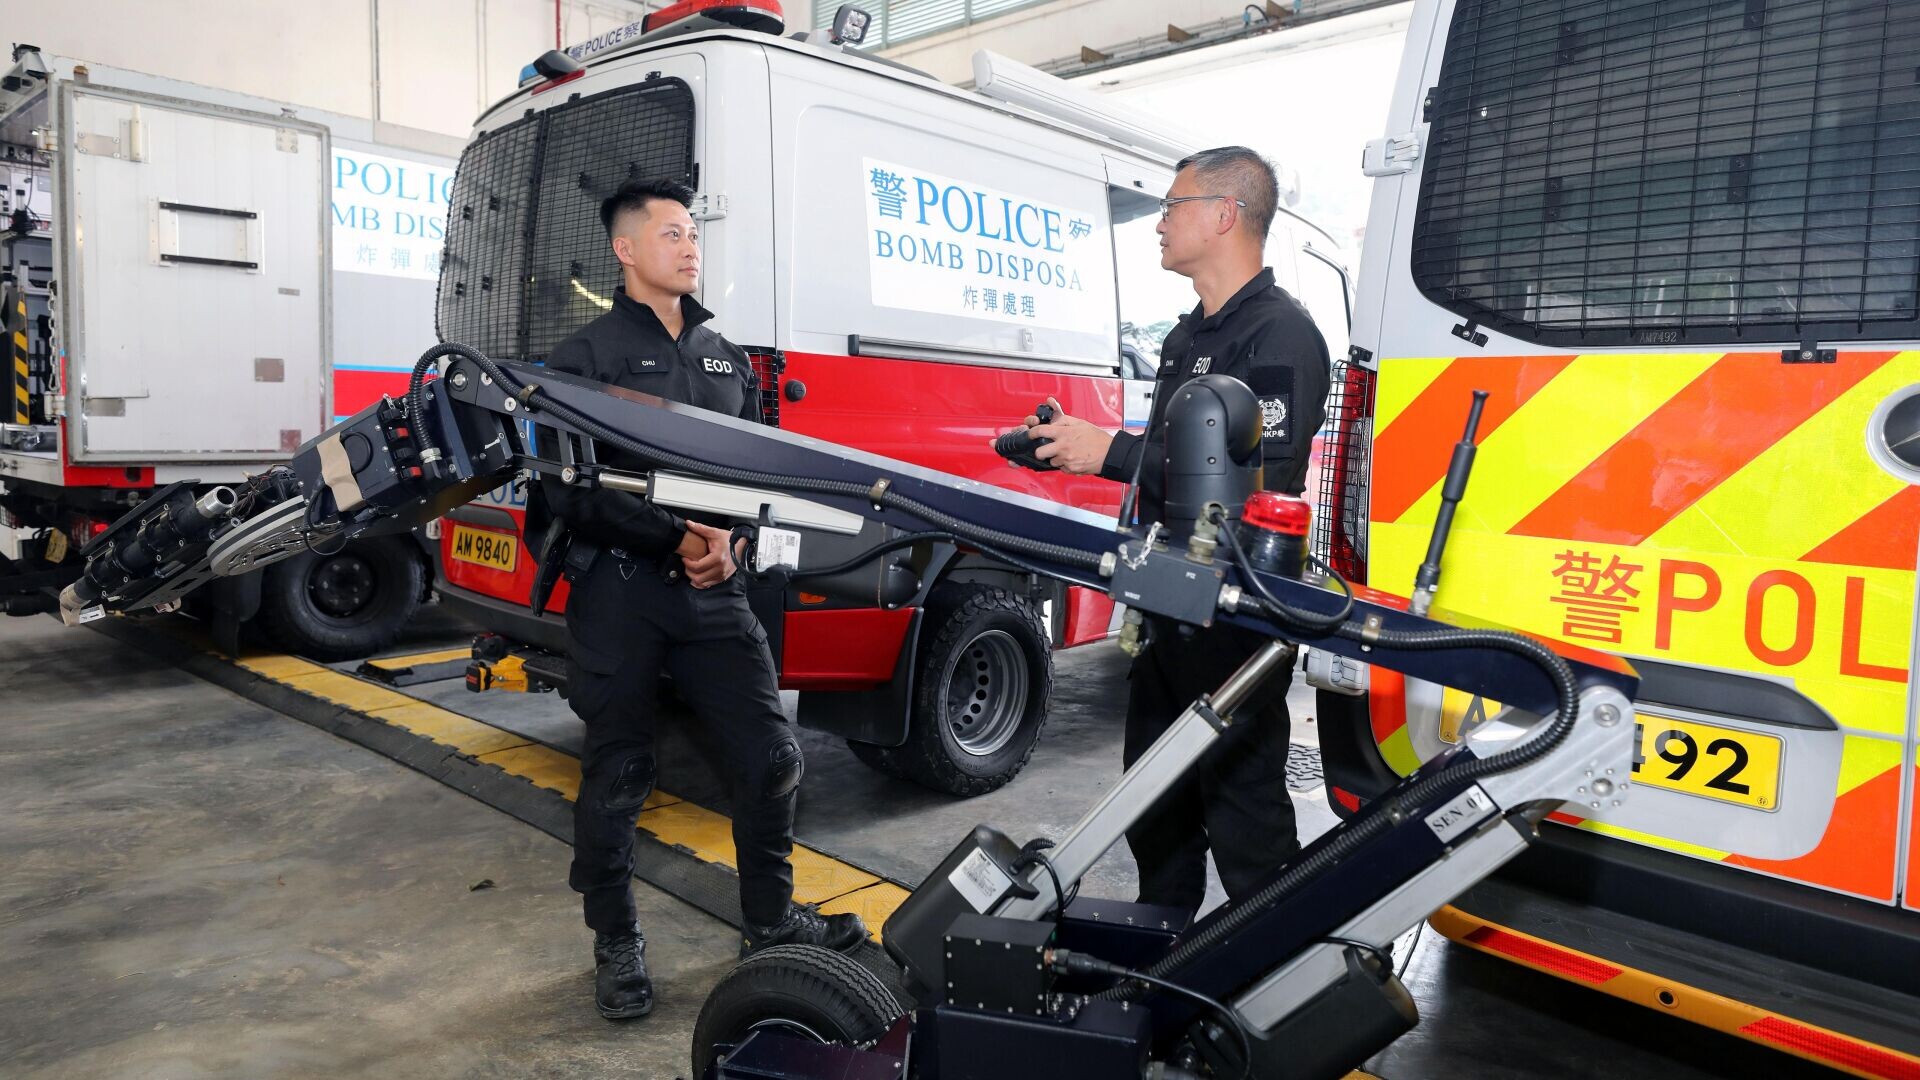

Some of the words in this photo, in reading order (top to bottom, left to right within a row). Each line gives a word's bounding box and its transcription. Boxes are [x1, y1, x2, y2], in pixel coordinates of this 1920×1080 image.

[585, 28, 623, 55] POLICE
[870, 168, 907, 220] 警
[912, 176, 1065, 253] POLICE
[874, 229, 964, 270] BOMB
[963, 285, 1036, 318] 炸彈處理
[703, 357, 733, 374] EOD
[1192, 356, 1212, 375] EOD
[456, 531, 473, 557] AM
[476, 535, 511, 566] 9840
[1549, 549, 1644, 645] 警
